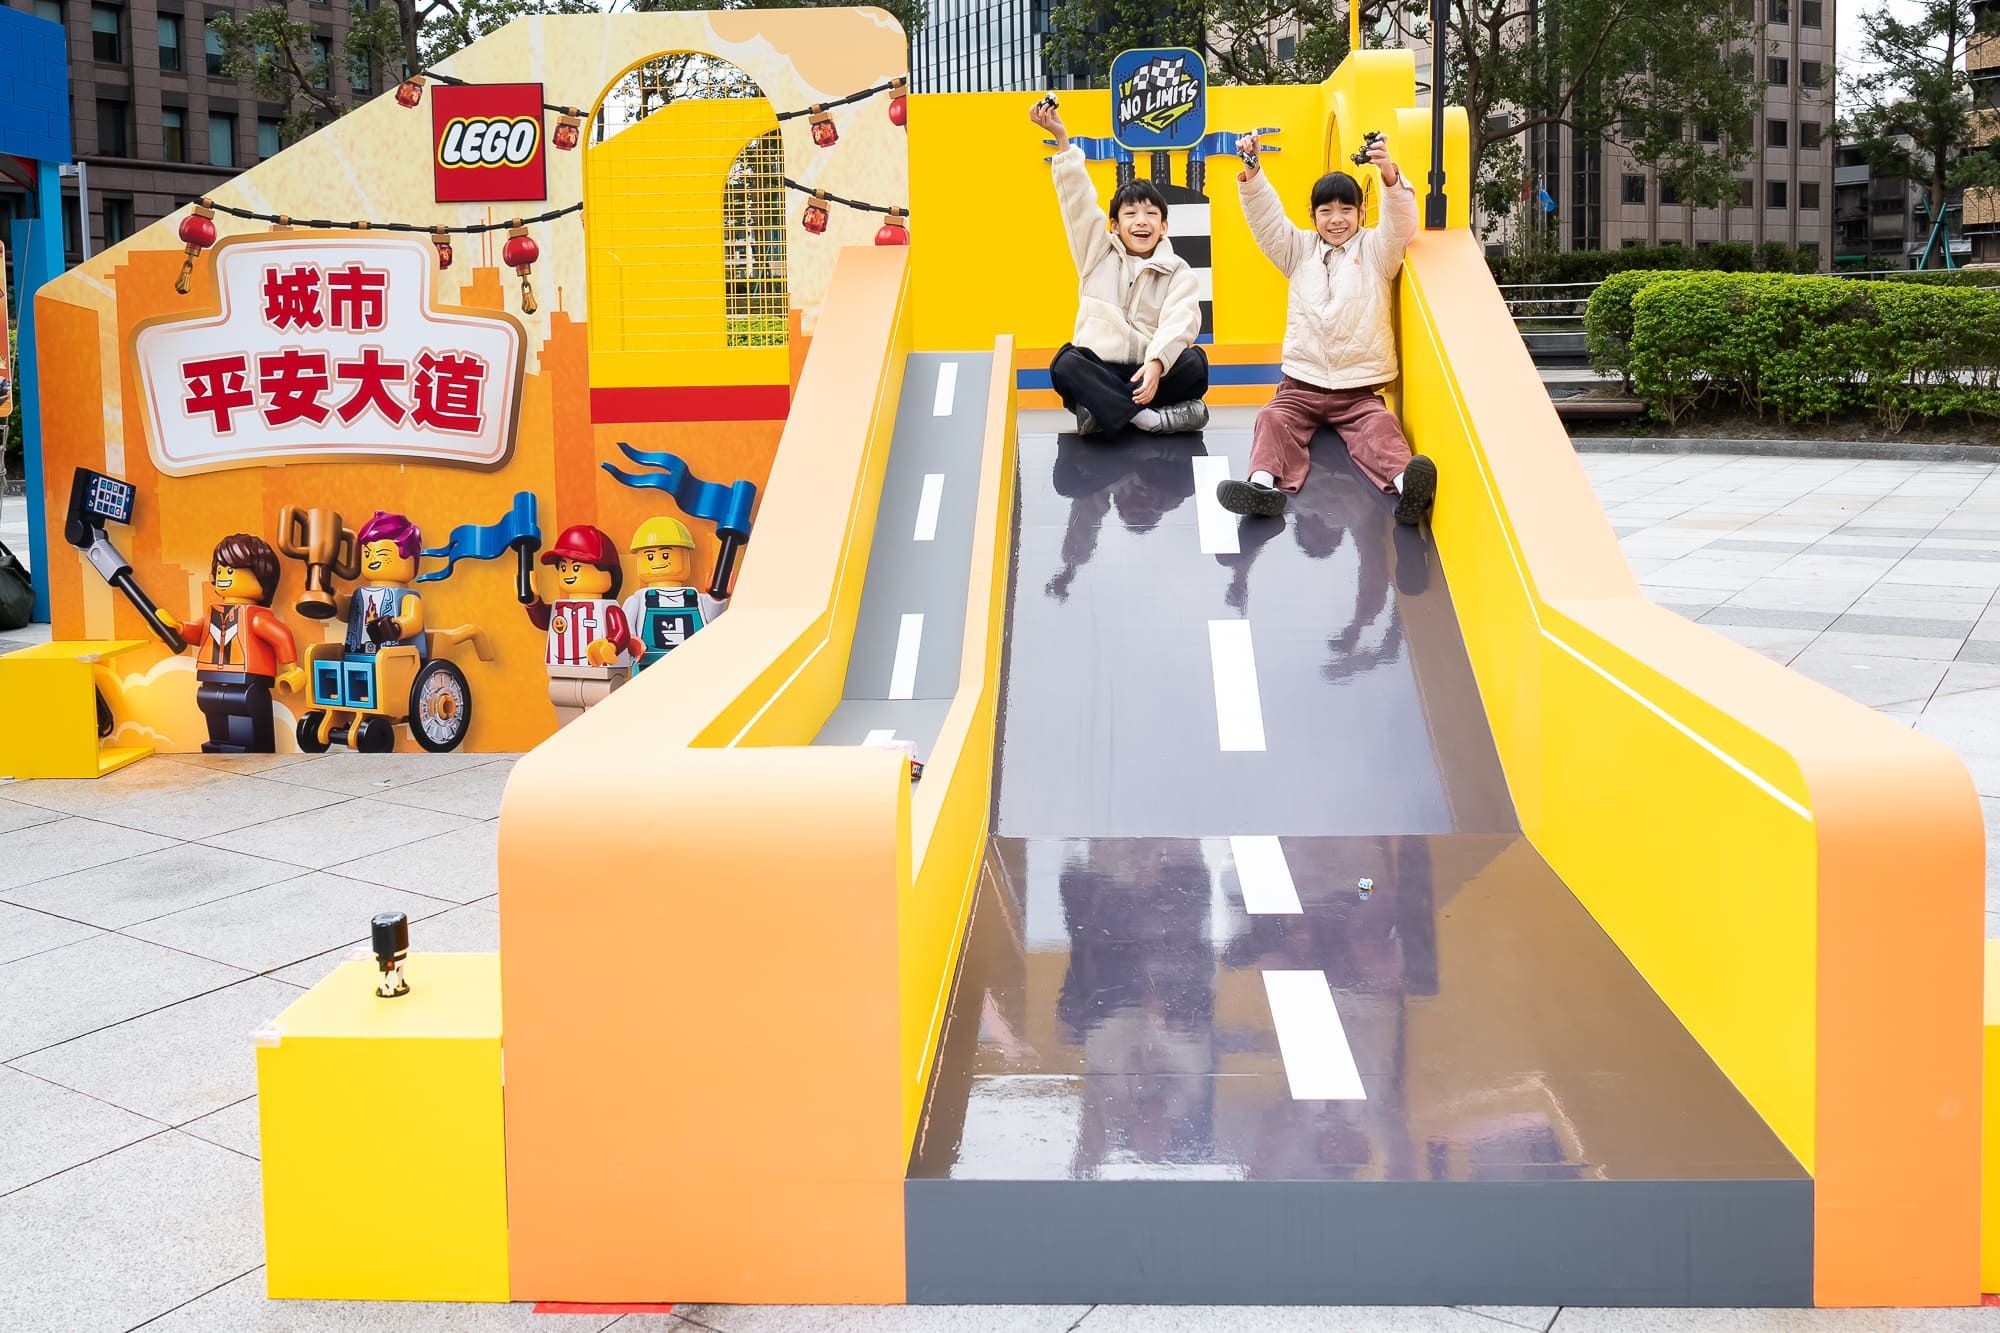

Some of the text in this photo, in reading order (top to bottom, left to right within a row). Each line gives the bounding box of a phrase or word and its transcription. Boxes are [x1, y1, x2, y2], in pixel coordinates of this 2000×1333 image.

[1119, 79, 1199, 122] NO LIMITS
[442, 120, 536, 164] LEGO
[263, 266, 386, 330] 城市
[182, 349, 484, 433] 平安大道
